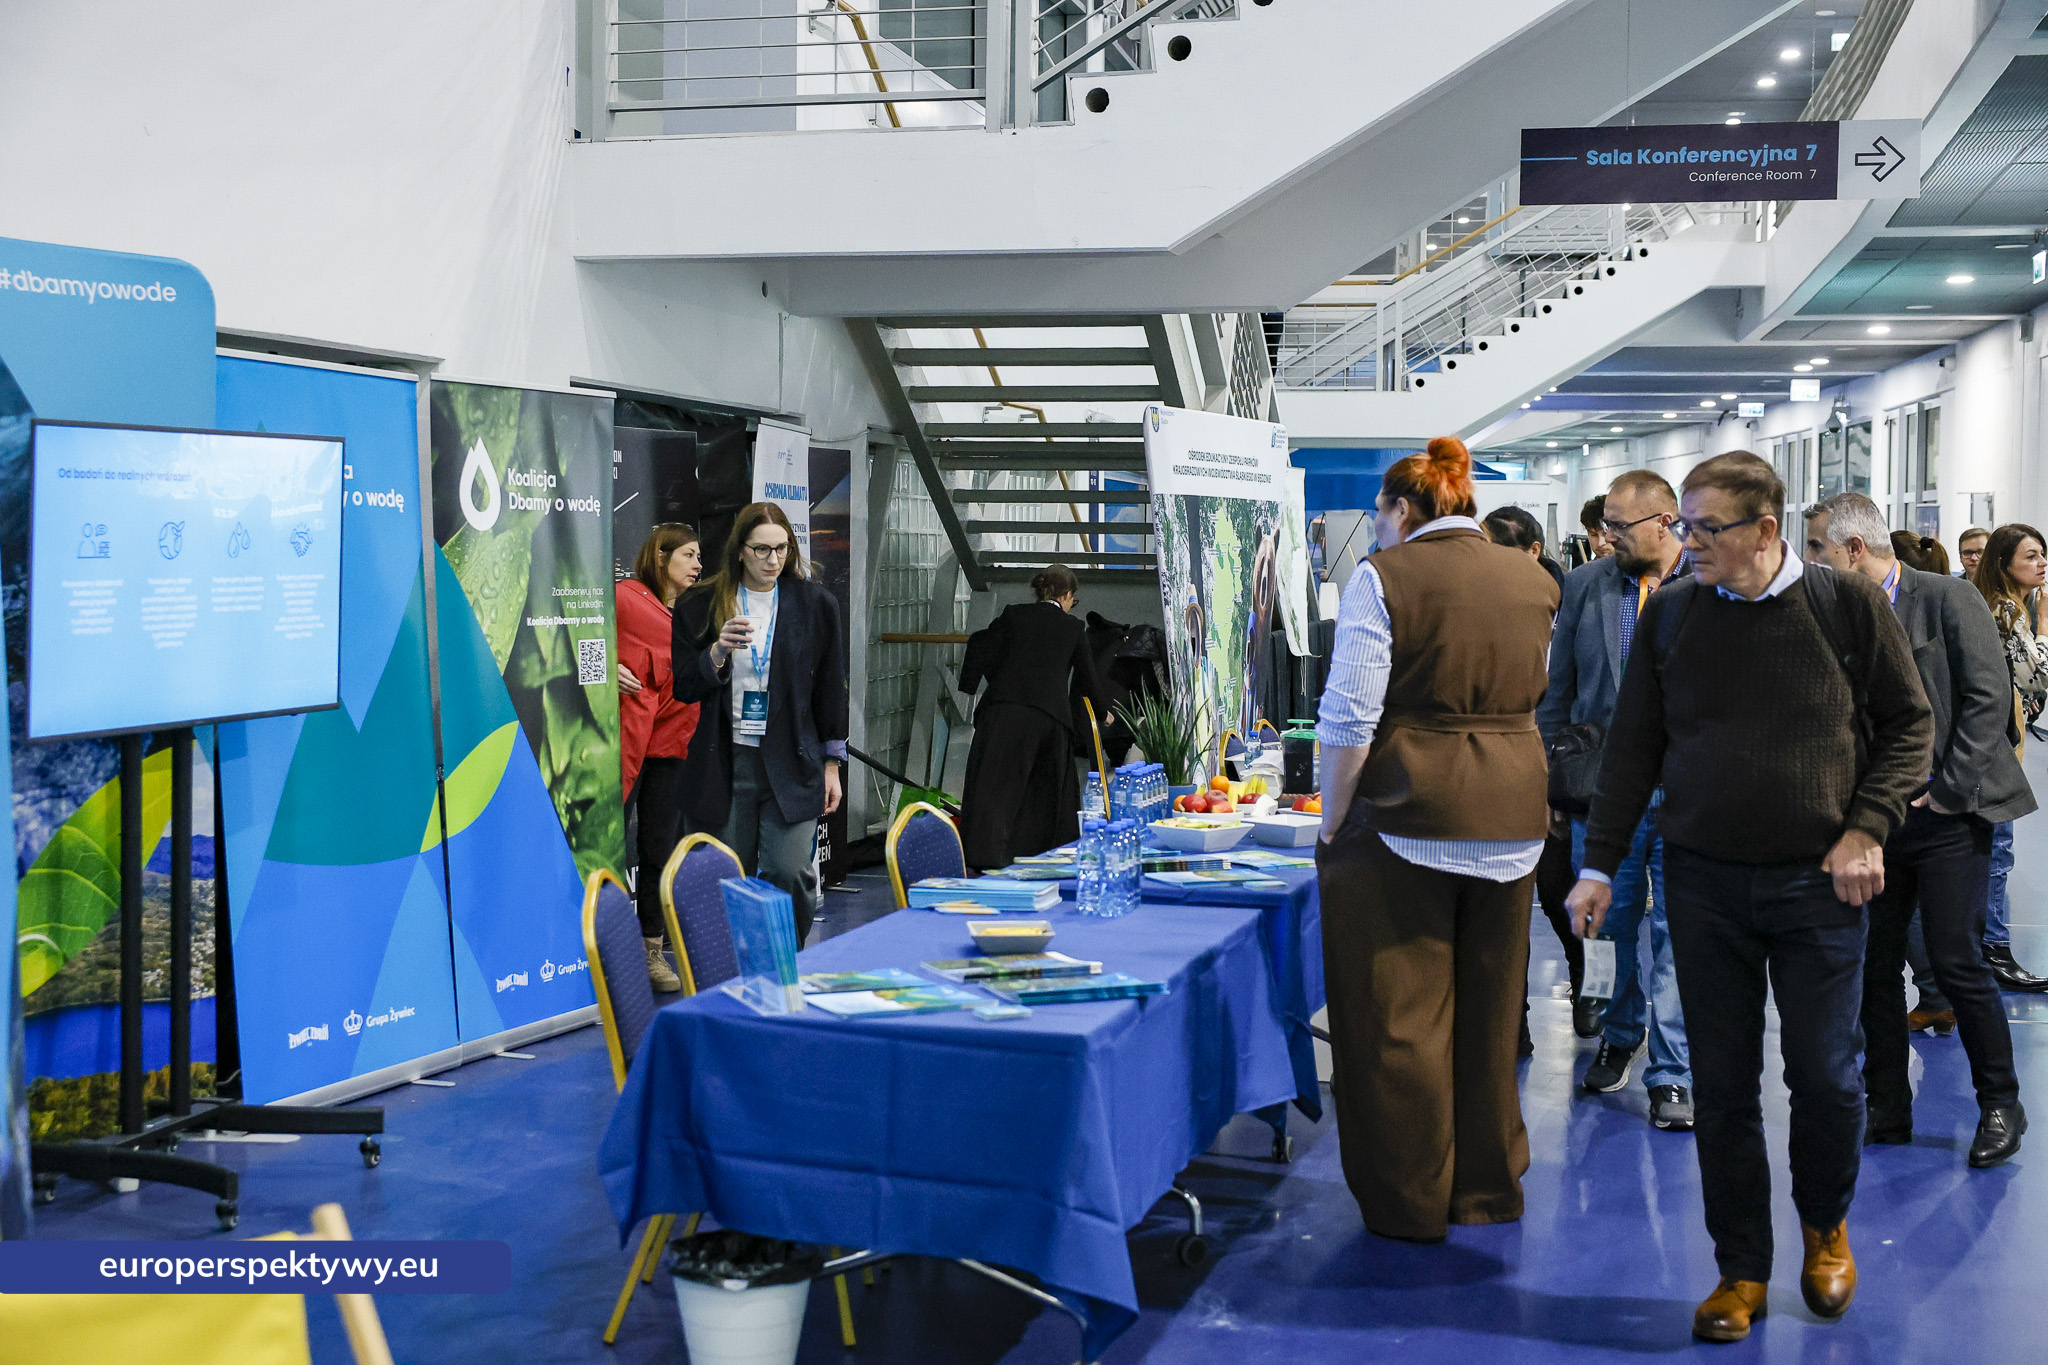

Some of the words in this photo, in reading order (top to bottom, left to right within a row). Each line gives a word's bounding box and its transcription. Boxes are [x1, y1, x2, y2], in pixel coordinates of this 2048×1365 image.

[1586, 148, 1633, 166] Sala
[1637, 144, 1798, 167] Konferencyjna
[1806, 144, 1818, 161] 7
[1688, 170, 1763, 182] Conference
[1765, 170, 1803, 181] Room
[1809, 169, 1817, 180] 7
[0, 268, 177, 304] #dbamyowode
[507, 467, 557, 492] Koalicja
[352, 490, 364, 506] o
[366, 488, 405, 513] wodę
[764, 482, 787, 500] OCHRONA
[508, 491, 552, 516] Dbamy
[554, 497, 565, 512] o
[567, 494, 601, 517] wodę
[551, 586, 592, 598] Zaobserwuj
[592, 587, 604, 596] nas
[566, 601, 577, 609] na
[526, 615, 554, 628] Koalicja
[553, 615, 581, 628] Dbamy
[587, 614, 605, 625] wodę
[558, 963, 577, 976] Grupa
[366, 1014, 389, 1028] Grupa
[389, 1006, 416, 1023] Żywiec
[288, 1027, 309, 1049] ŻYWIEC
[310, 1023, 329, 1041] ZDRÓJ
